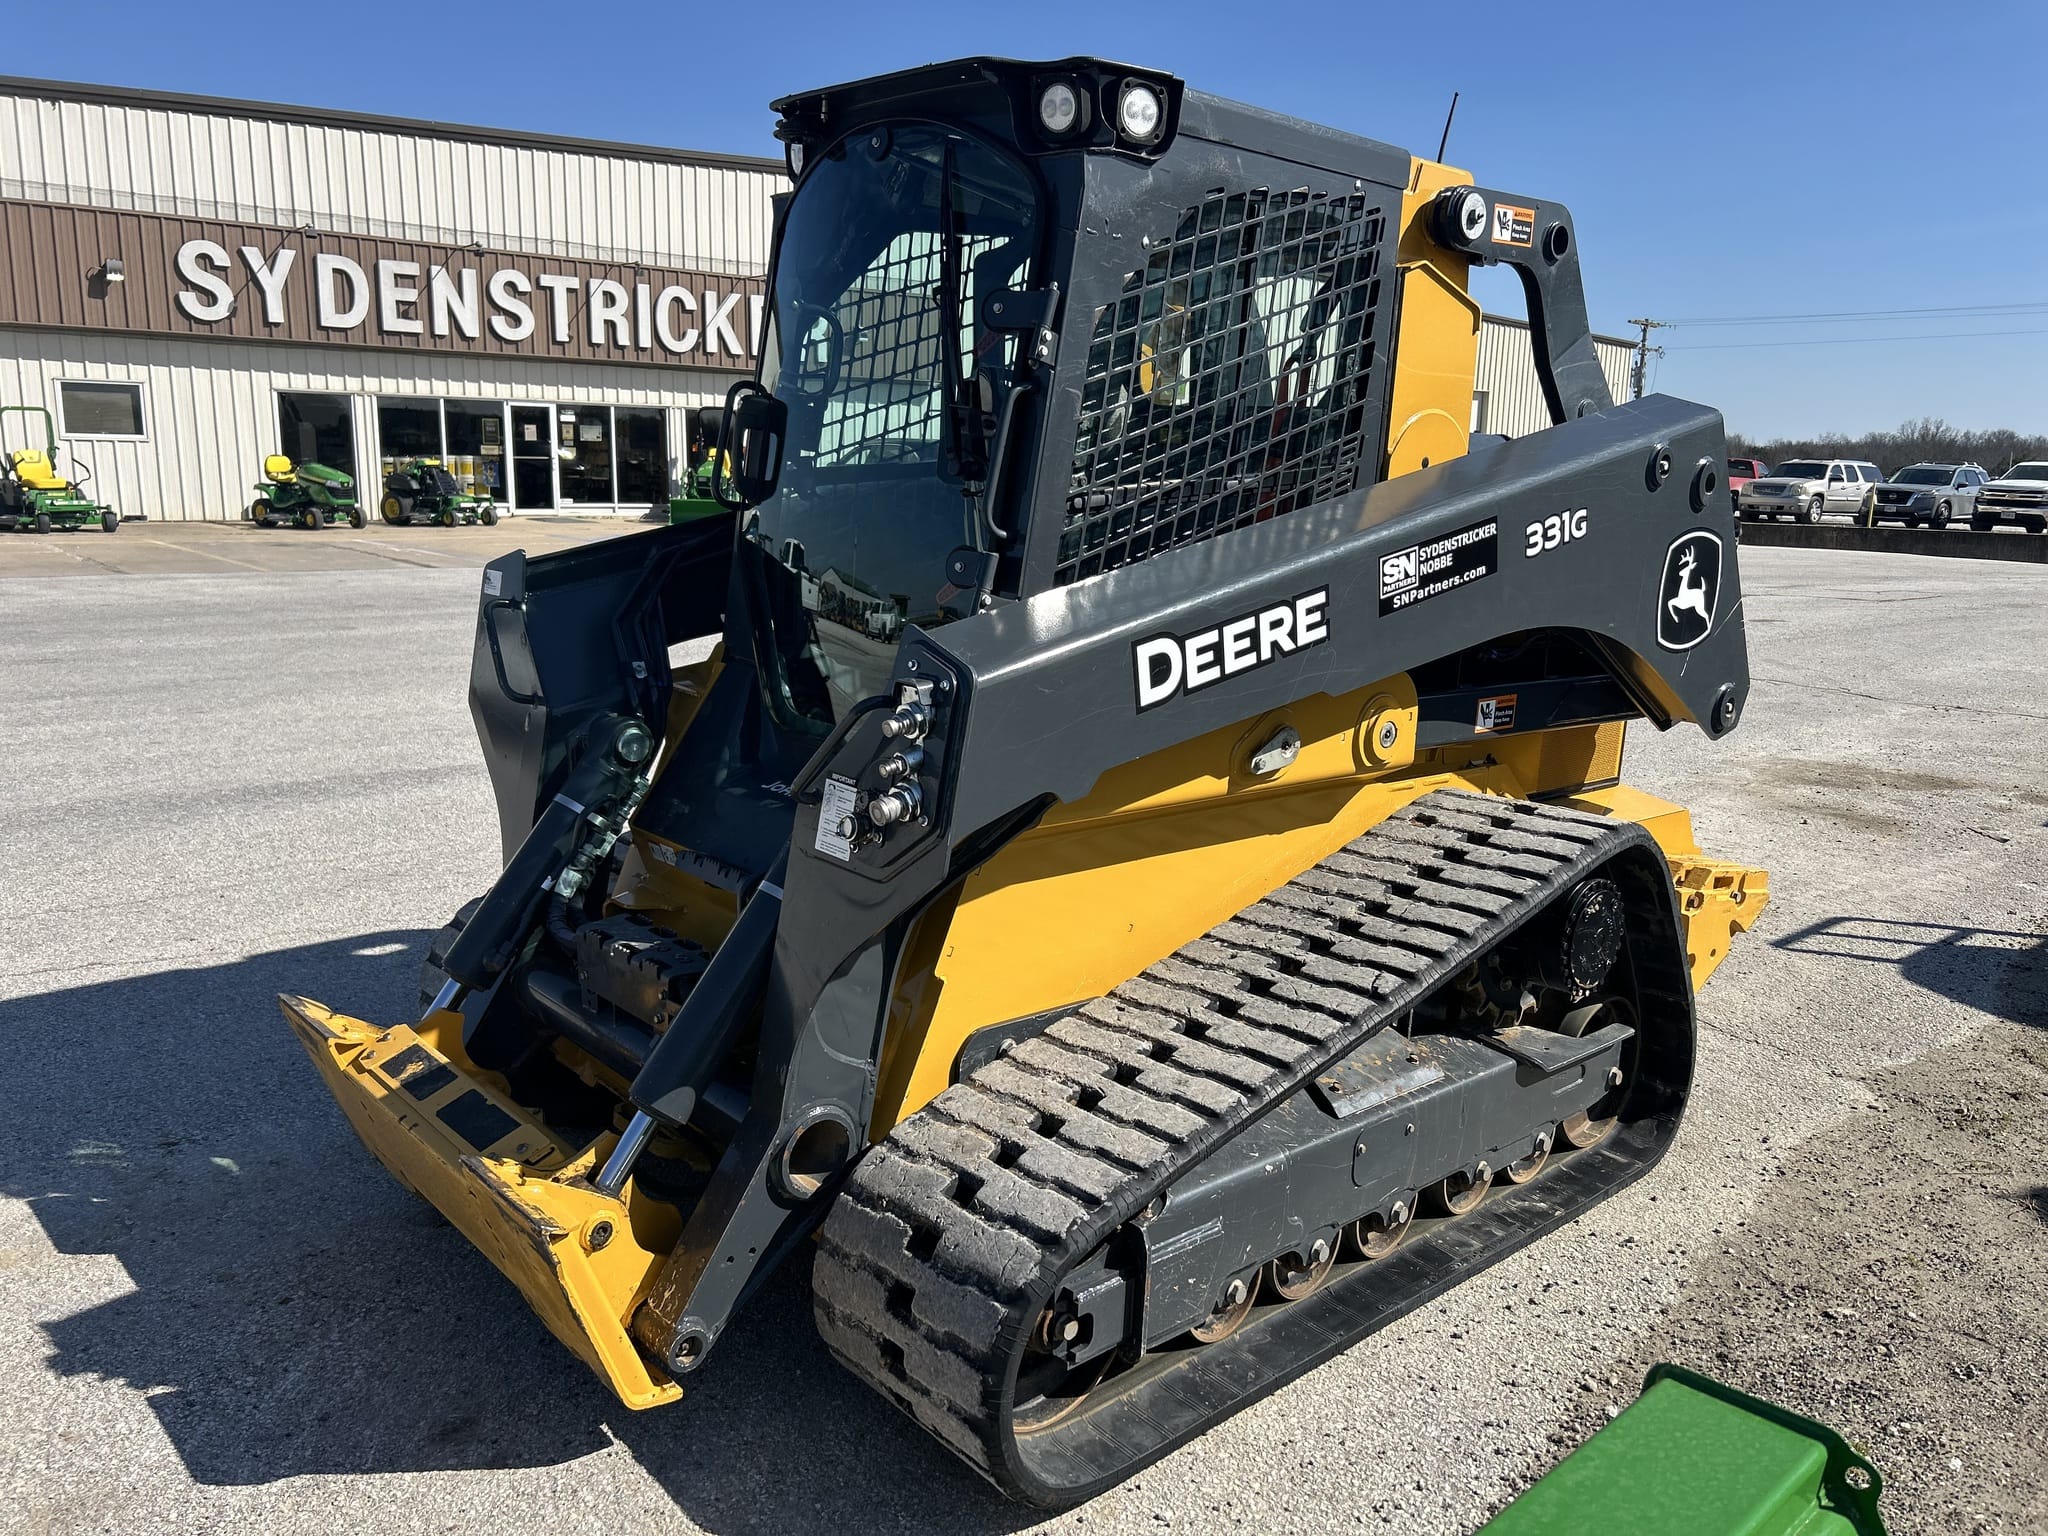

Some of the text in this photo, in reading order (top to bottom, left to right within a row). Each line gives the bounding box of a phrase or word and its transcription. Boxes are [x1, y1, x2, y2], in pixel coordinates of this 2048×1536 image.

[1419, 523, 1497, 561] SYDENSTRICKER
[1526, 508, 1588, 557] 331G
[1383, 552, 1416, 585] SN
[1419, 553, 1453, 576] NOBBE
[1383, 576, 1416, 594] PARTNERS
[1393, 564, 1486, 608] SNPartners.com
[1136, 590, 1327, 707] DEERE
